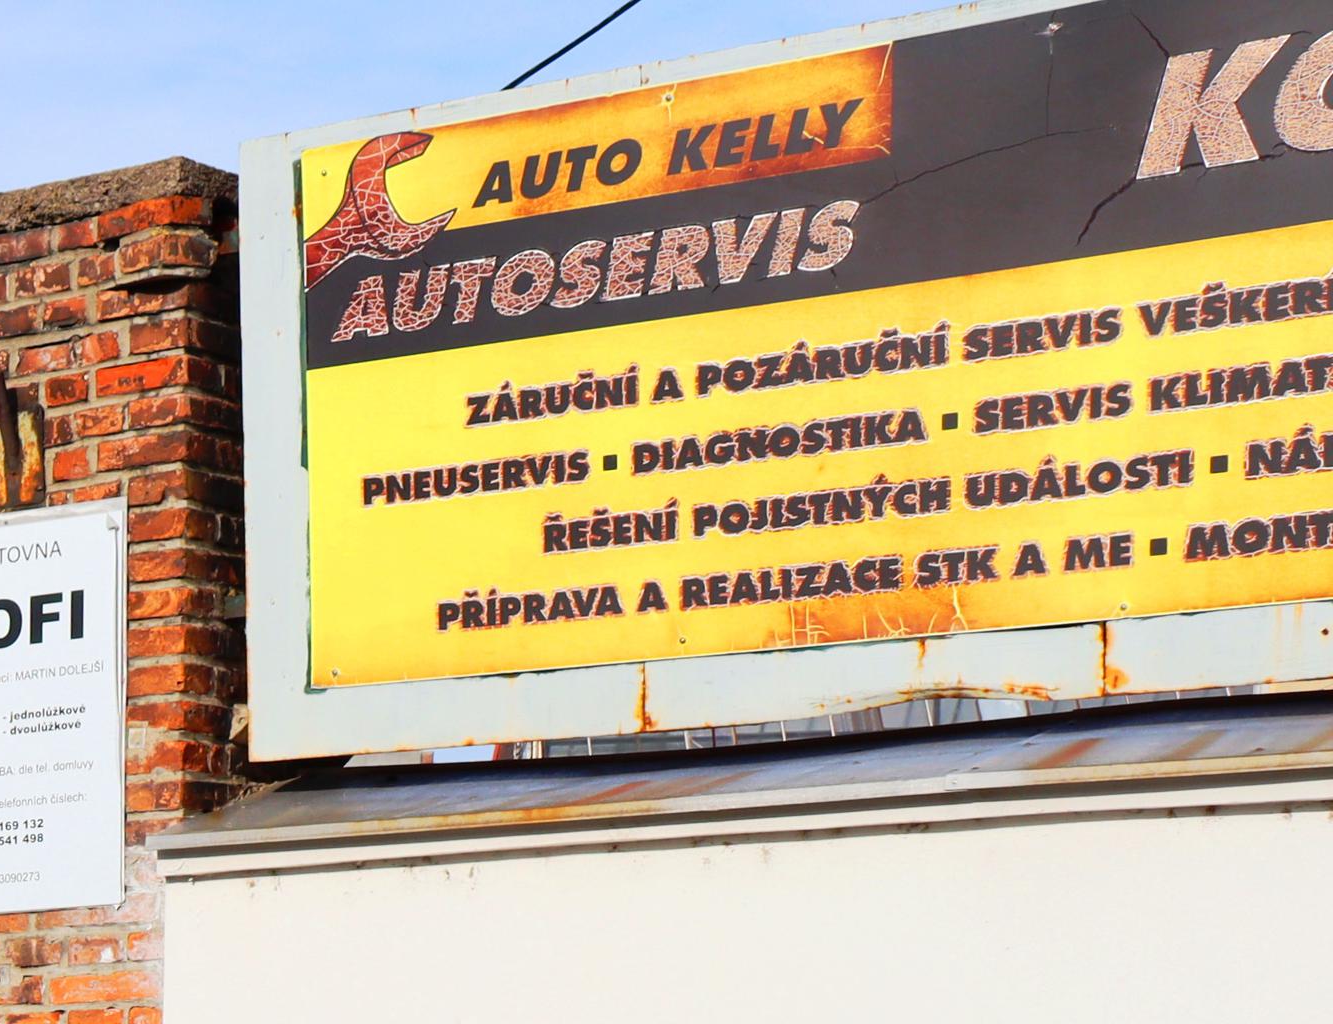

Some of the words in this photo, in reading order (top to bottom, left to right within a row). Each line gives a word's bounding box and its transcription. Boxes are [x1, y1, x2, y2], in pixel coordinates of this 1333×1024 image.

[472, 137, 642, 209] AUTO
[666, 98, 864, 176] KELLY
[331, 199, 861, 343] AUTOSERVIS
[464, 363, 640, 428] ZÁRUČNÍ
[649, 367, 683, 404] A
[961, 306, 1123, 363] SERVIS
[1136, 270, 1333, 338] VEŠKER
[361, 449, 590, 508] PNEUSERVIS
[630, 407, 930, 476] DIAGNOSTIKA
[971, 381, 1132, 435] SERVIS
[542, 498, 679, 555] ŘEŠENÍ
[691, 473, 952, 540] POJISTNÝCH
[964, 449, 1196, 511] UDÁLOSTI
[436, 586, 625, 633] PŘÍPRAVA
[636, 579, 668, 614] A
[679, 555, 903, 612] REALIZACE
[913, 546, 1000, 591] STK
[1012, 542, 1049, 580] A
[1063, 531, 1134, 574] ME
[15, 667, 56, 682] MARTIN
[59, 660, 105, 677] DOLEJŠÍ
[9, 703, 86, 723] jednolůžkové
[9, 720, 82, 736] dvoulůžkové
[19, 763, 33, 775] dle
[53, 758, 94, 772] domluvy
[0, 820, 19, 832] 169
[23, 818, 44, 829] 132
[23, 833, 44, 844] 498
